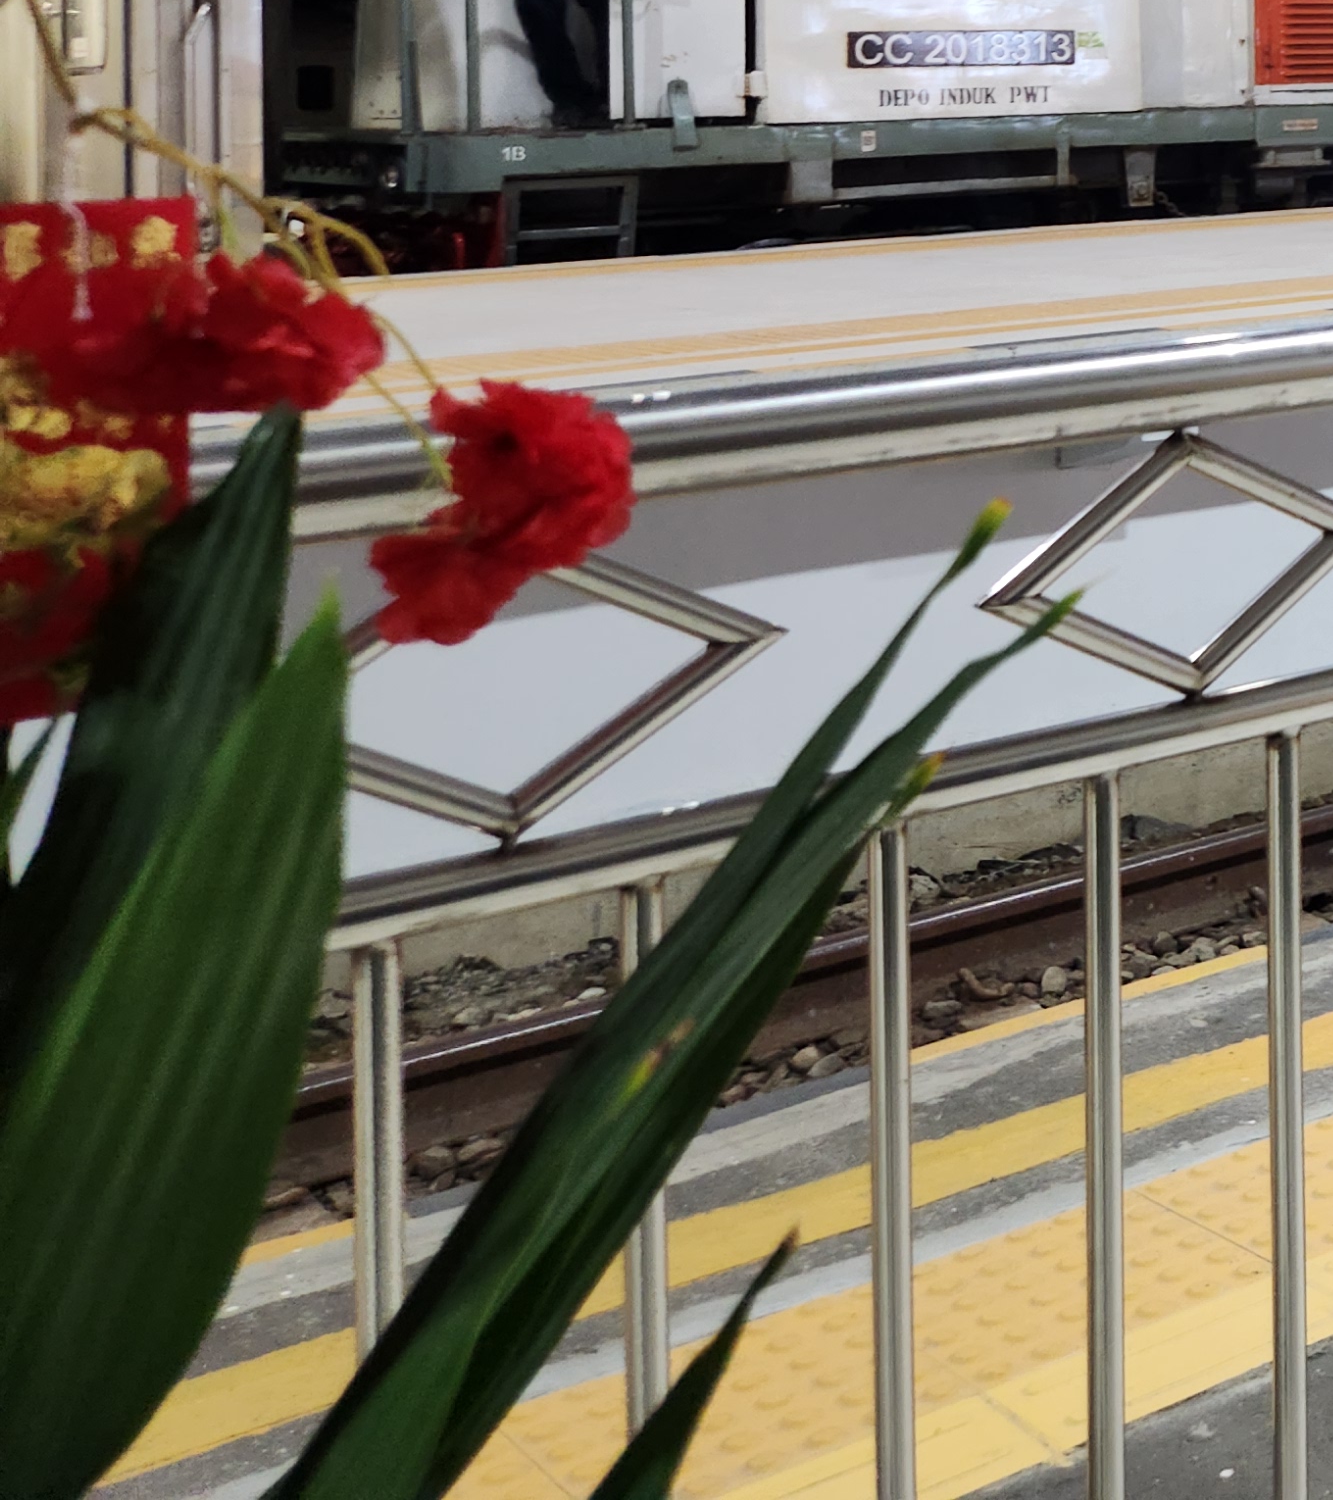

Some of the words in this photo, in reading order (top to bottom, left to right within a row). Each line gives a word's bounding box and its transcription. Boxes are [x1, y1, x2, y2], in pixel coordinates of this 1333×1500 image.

[854, 33, 913, 65] CC
[923, 32, 1072, 63] 2018313
[878, 88, 930, 107] DEPO
[939, 86, 997, 105] INDUK
[1009, 85, 1051, 103] PWT
[501, 145, 527, 161] 1B
